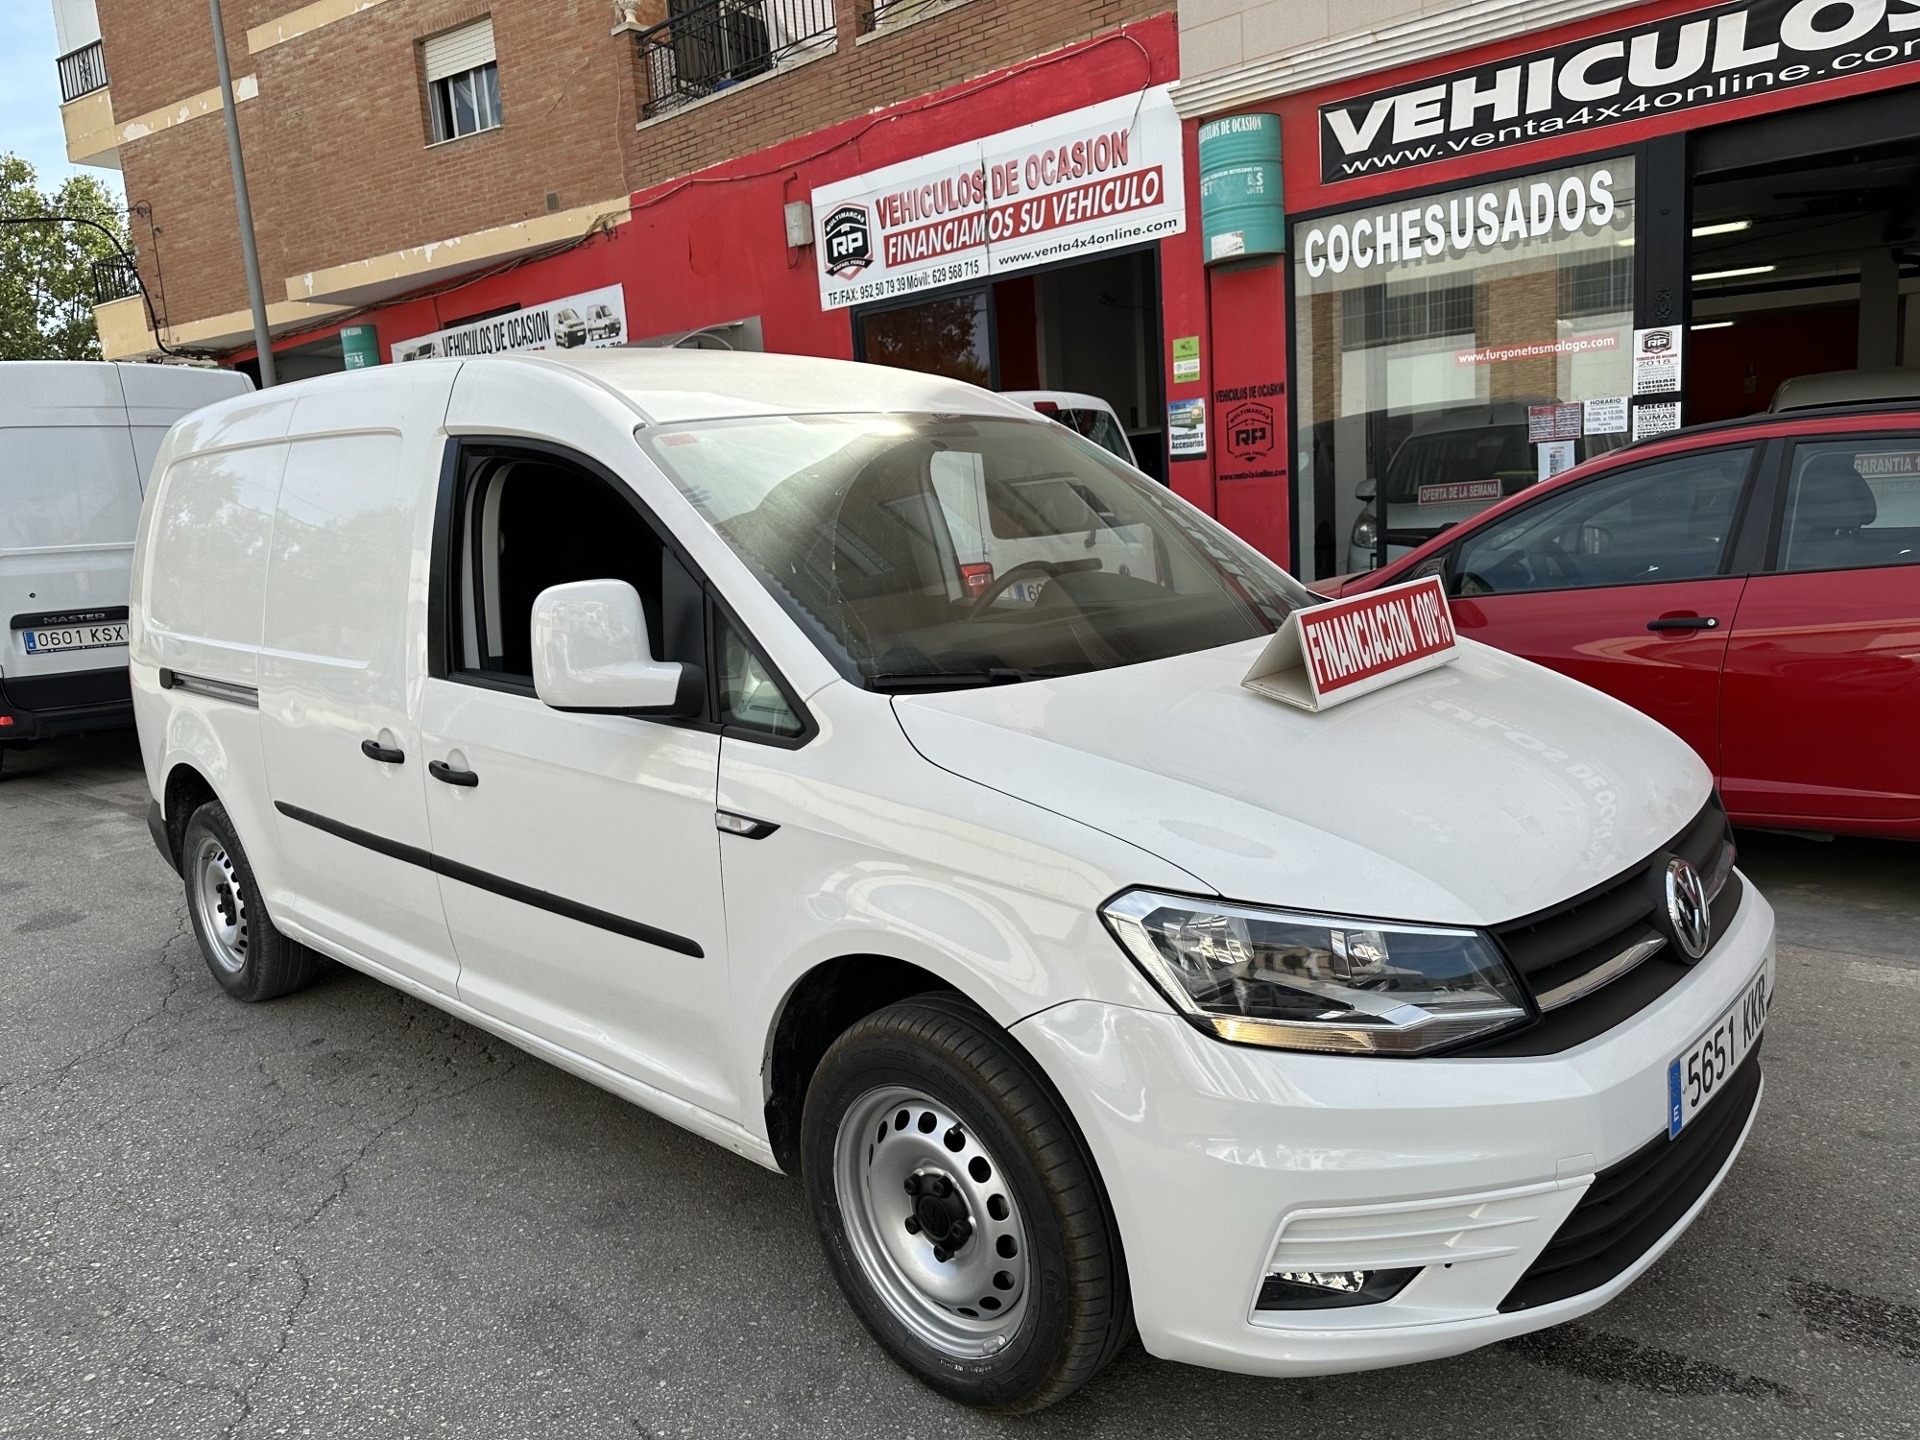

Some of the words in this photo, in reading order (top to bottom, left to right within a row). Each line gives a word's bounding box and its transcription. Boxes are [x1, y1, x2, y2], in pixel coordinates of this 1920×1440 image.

[1220, 120, 1230, 137] DE
[1231, 116, 1262, 135] OCASION
[875, 169, 984, 230] VEHICULOS
[991, 159, 1020, 200] DE
[1025, 129, 1129, 190] OCASION
[826, 211, 866, 232] MULTIMARCAS
[888, 209, 1014, 265] FINANCIAMOS
[1018, 199, 1046, 234] SU
[1052, 171, 1160, 225] VEHICULO
[832, 231, 864, 257] RP
[998, 218, 1177, 266] www.venta4x4online.com
[833, 262, 850, 272] RAFAEL
[860, 284, 874, 300] 952
[875, 280, 884, 297] 50
[886, 279, 895, 295] 79
[896, 276, 906, 292] 39
[906, 273, 930, 290] Móvil:
[932, 268, 946, 284] 629
[949, 264, 962, 280] 568
[965, 260, 979, 276] 715
[442, 326, 492, 358] VEHICULOS
[494, 321, 507, 351] DE
[507, 310, 550, 348] OCASION
[1647, 338, 1668, 348] RP
[1458, 335, 1615, 364] www.furgonetasmalaga.com
[1639, 358, 1671, 367] 2018
[1215, 387, 1248, 403] VEHICULOS
[1249, 385, 1257, 399] DE
[1258, 382, 1285, 397] OCASION
[1590, 398, 1622, 406] HORARIO
[1229, 408, 1270, 423] MULTIMARCAS
[1171, 431, 1199, 441] Remolques
[1171, 439, 1205, 450] Accesorios
[1235, 427, 1266, 447] RP
[1854, 457, 1911, 473] GARANTIA
[1422, 487, 1448, 501] OFERTA
[1448, 486, 1458, 499] DE
[1460, 485, 1468, 498] LA
[1469, 482, 1497, 497] SEMANA
[43, 612, 106, 624] MASTER
[38, 630, 83, 647] 0601
[90, 626, 124, 643] KSX
[1306, 597, 1417, 684] FINANCIACION
[1410, 589, 1450, 649] 100%
[1687, 1015, 1735, 1108] 5651
[1742, 973, 1766, 1049] KKR
